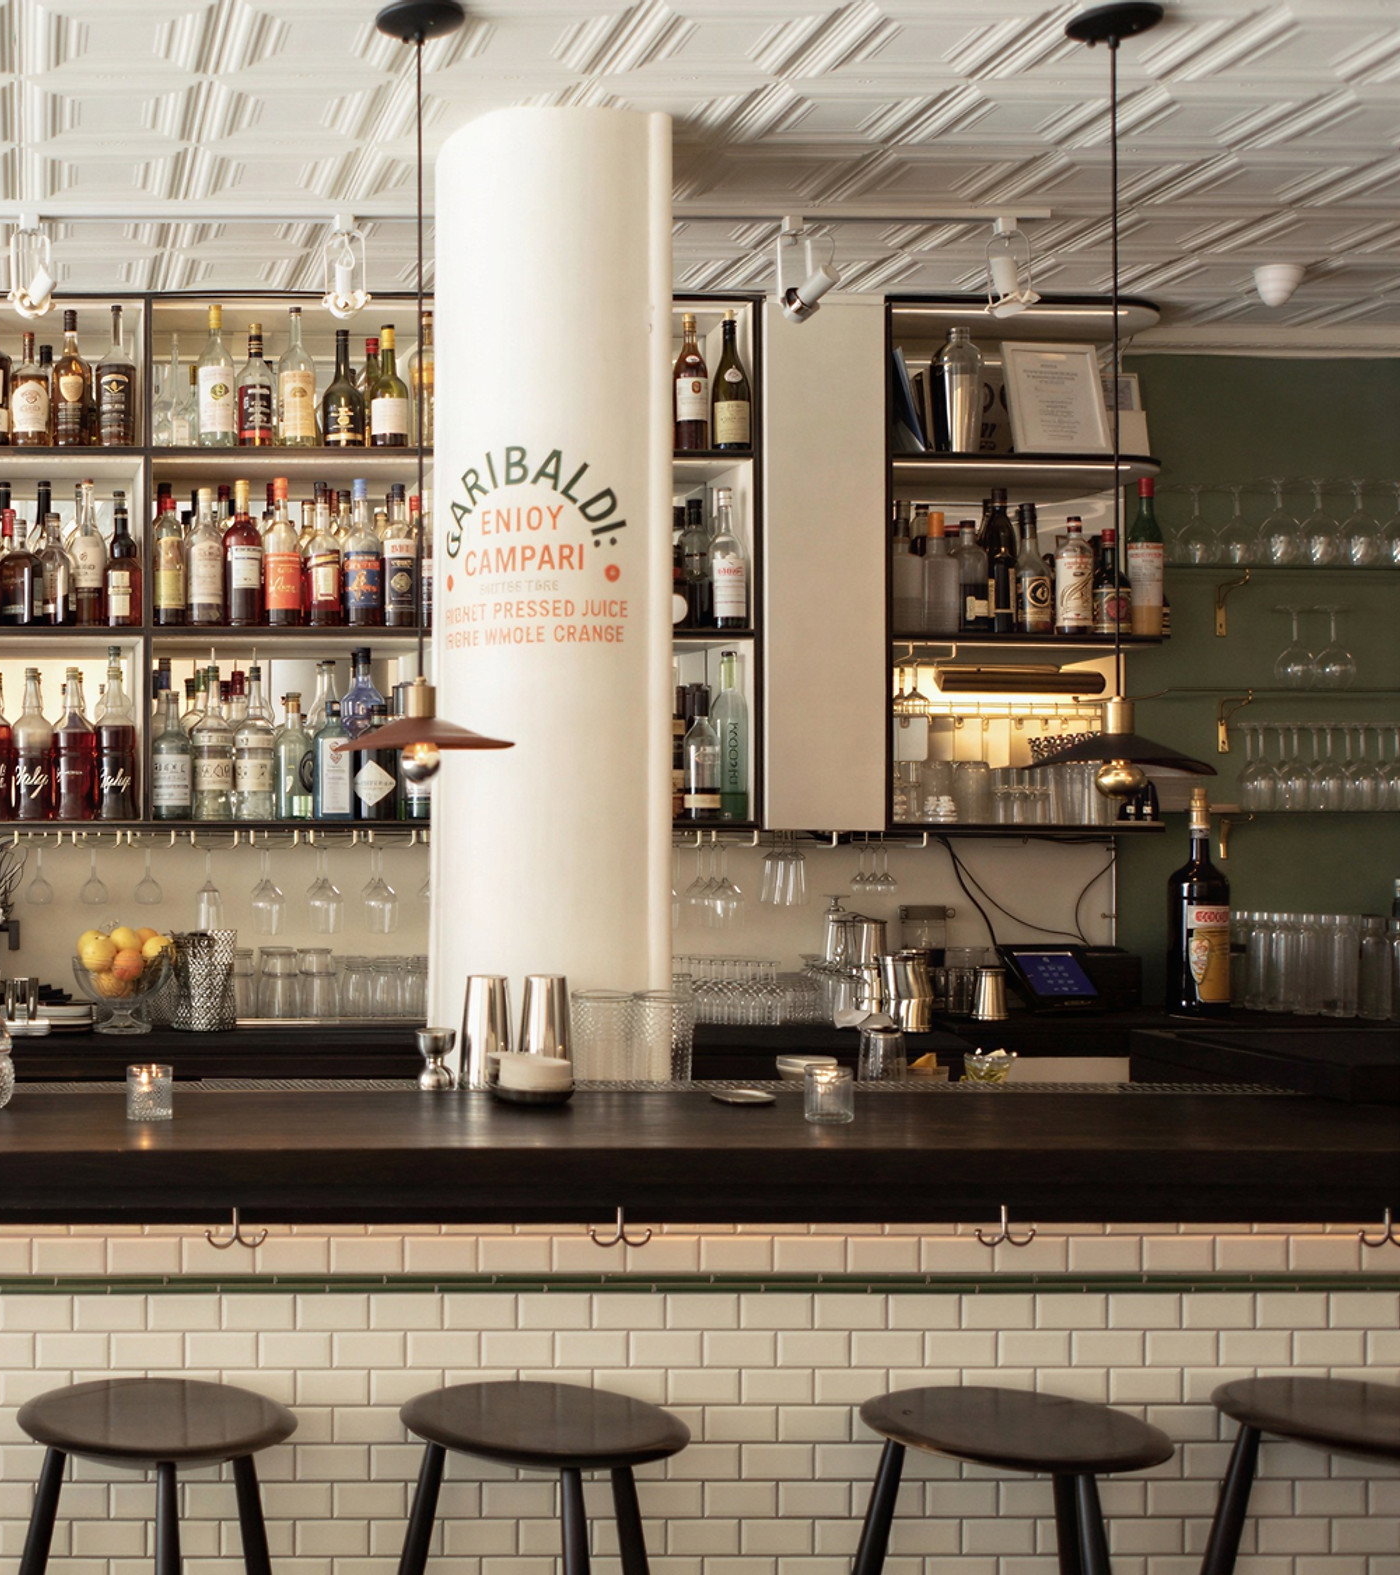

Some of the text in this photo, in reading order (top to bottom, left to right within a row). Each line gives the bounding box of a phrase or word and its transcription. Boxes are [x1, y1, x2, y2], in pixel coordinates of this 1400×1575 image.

[465, 543, 584, 577] CAMPARI
[493, 599, 575, 619] PRESSED
[581, 599, 628, 618] JUICE
